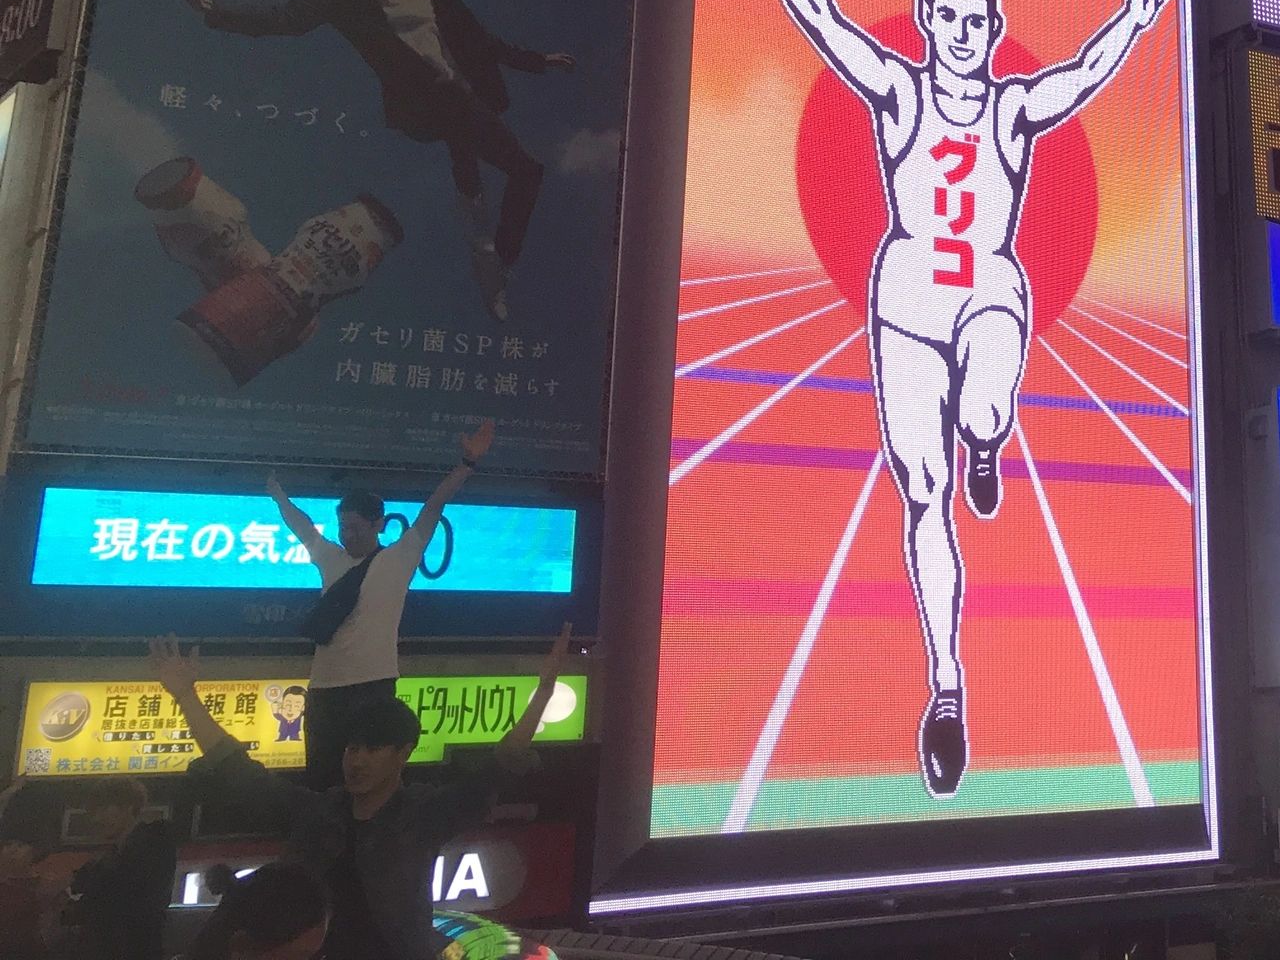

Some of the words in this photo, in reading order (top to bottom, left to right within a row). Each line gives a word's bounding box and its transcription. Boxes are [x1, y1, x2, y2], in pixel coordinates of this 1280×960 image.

[928, 133, 980, 288] グリコ
[417, 685, 516, 735] ピタットハウス
[56, 756, 120, 772] 株式会社
